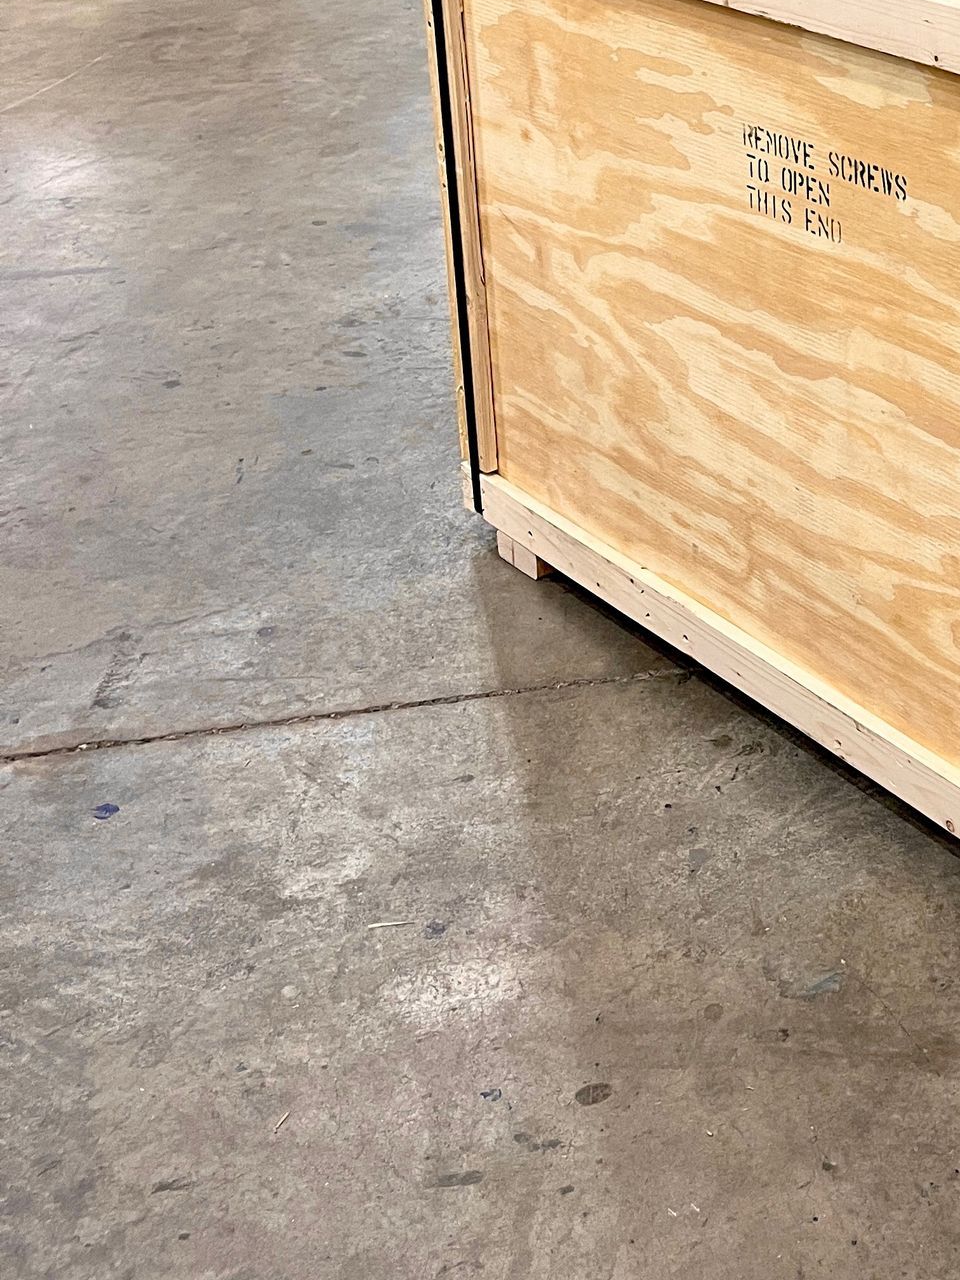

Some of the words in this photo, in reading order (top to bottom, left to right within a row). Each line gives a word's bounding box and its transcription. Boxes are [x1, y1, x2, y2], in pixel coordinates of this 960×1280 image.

[742, 123, 815, 170] REMOVE
[828, 151, 907, 201] SCREWS
[746, 153, 770, 183] TO
[781, 167, 830, 207] OPEN
[746, 184, 792, 224] THIS
[805, 207, 842, 244] END
